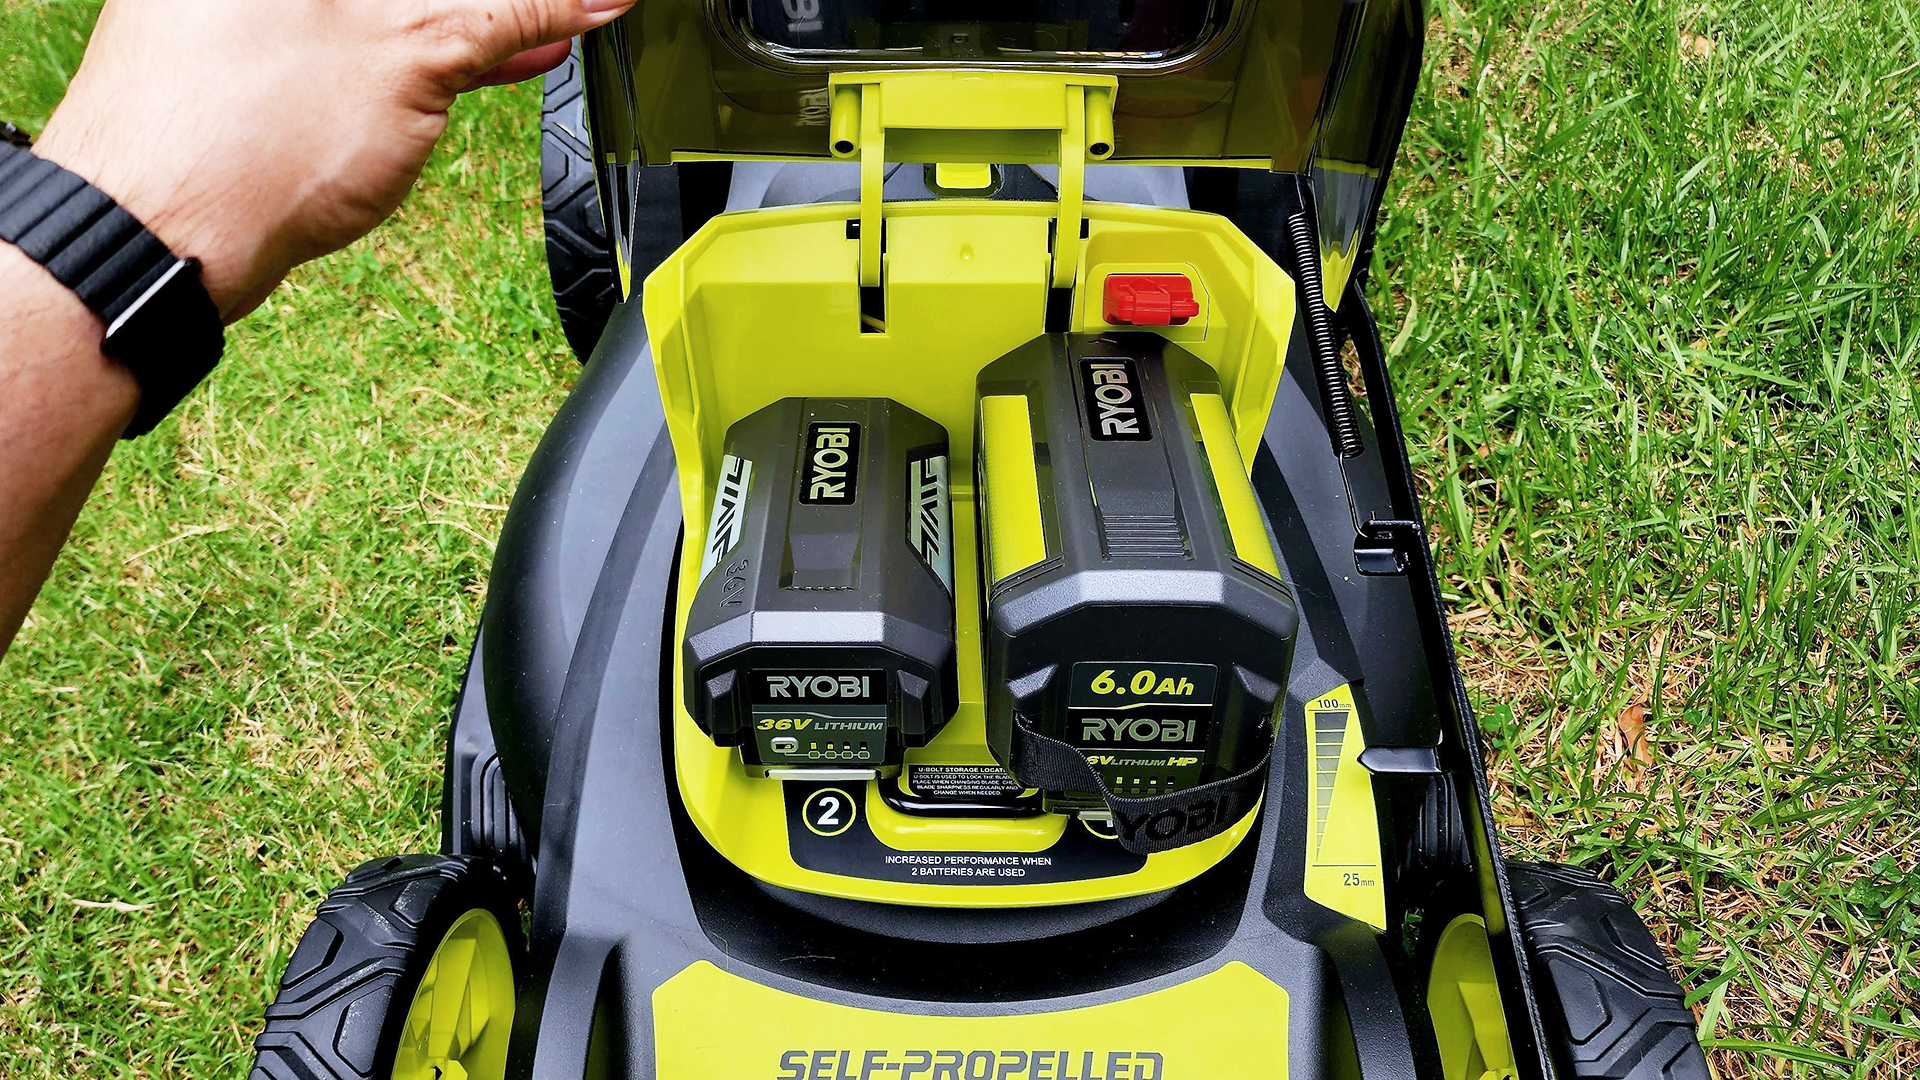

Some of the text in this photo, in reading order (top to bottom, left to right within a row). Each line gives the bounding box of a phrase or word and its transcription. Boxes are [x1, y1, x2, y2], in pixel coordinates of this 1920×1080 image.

[1090, 363, 1140, 436] RYOBI
[809, 427, 850, 500] RYOBI
[720, 558, 749, 608] 36V
[765, 675, 870, 698] RYOBI
[1090, 669, 1195, 696] 6.0Ah
[756, 718, 884, 731] 36V LITHIUM
[1081, 717, 1196, 742] RYOBI
[1086, 755, 1198, 767] 6V LITHIUM HP
[816, 796, 840, 826] 2
[1114, 794, 1228, 842] YOBI
[885, 855, 1052, 866] INCREASED PERFORMANCE WHEN
[911, 867, 1026, 877] 2 BATTERIES ARE USED
[776, 1049, 1165, 1080] SELF-PROPELLED
